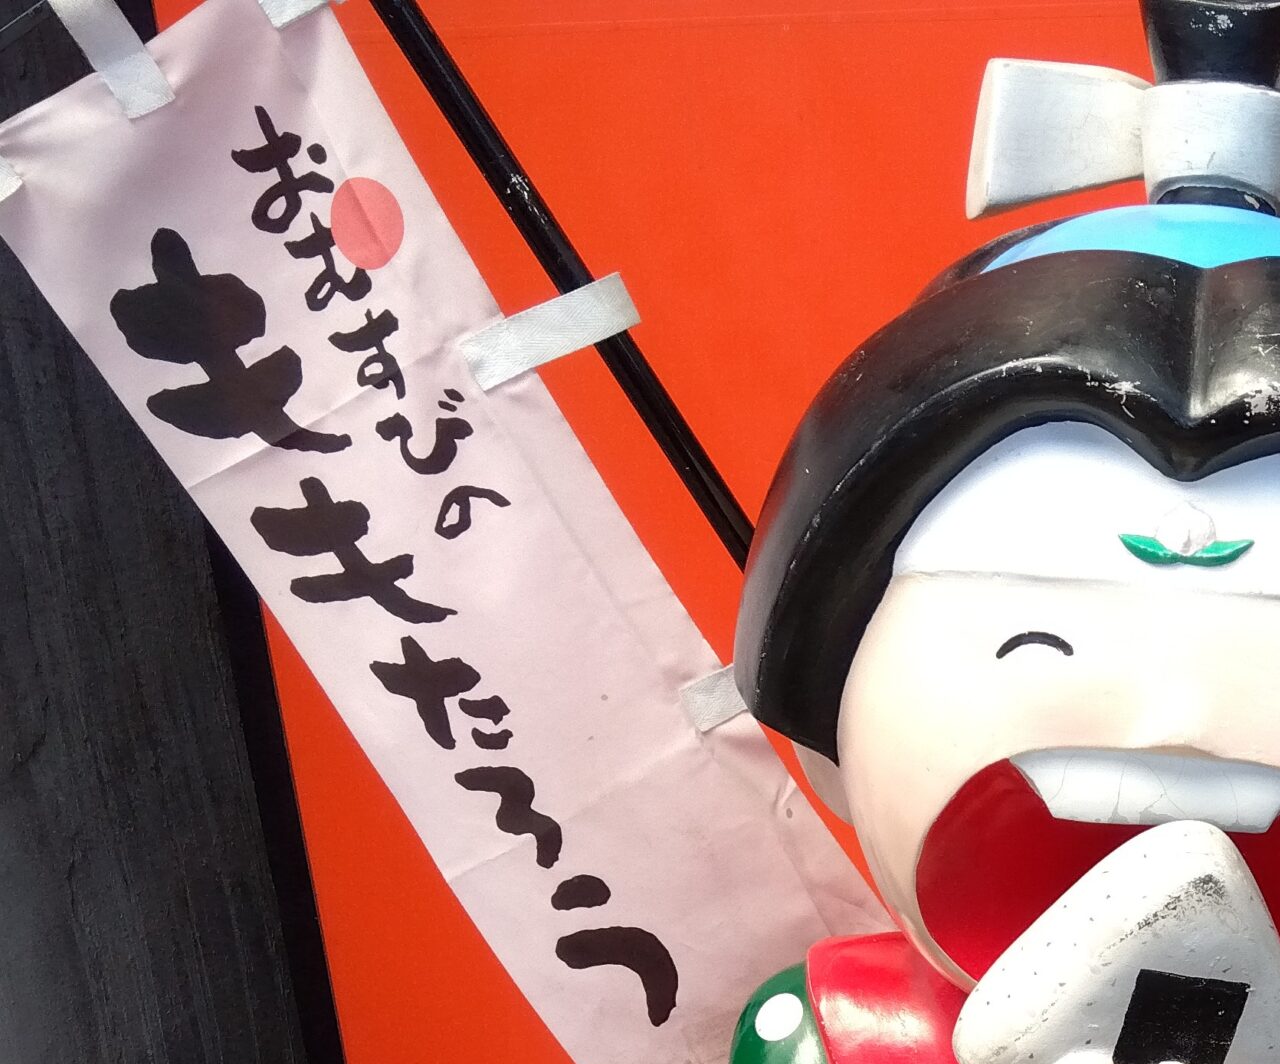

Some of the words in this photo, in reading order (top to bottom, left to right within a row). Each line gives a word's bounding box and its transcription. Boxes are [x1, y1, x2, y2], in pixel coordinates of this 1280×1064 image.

[110, 227, 678, 1027] ももたろう
[231, 105, 510, 541] おむすびの
